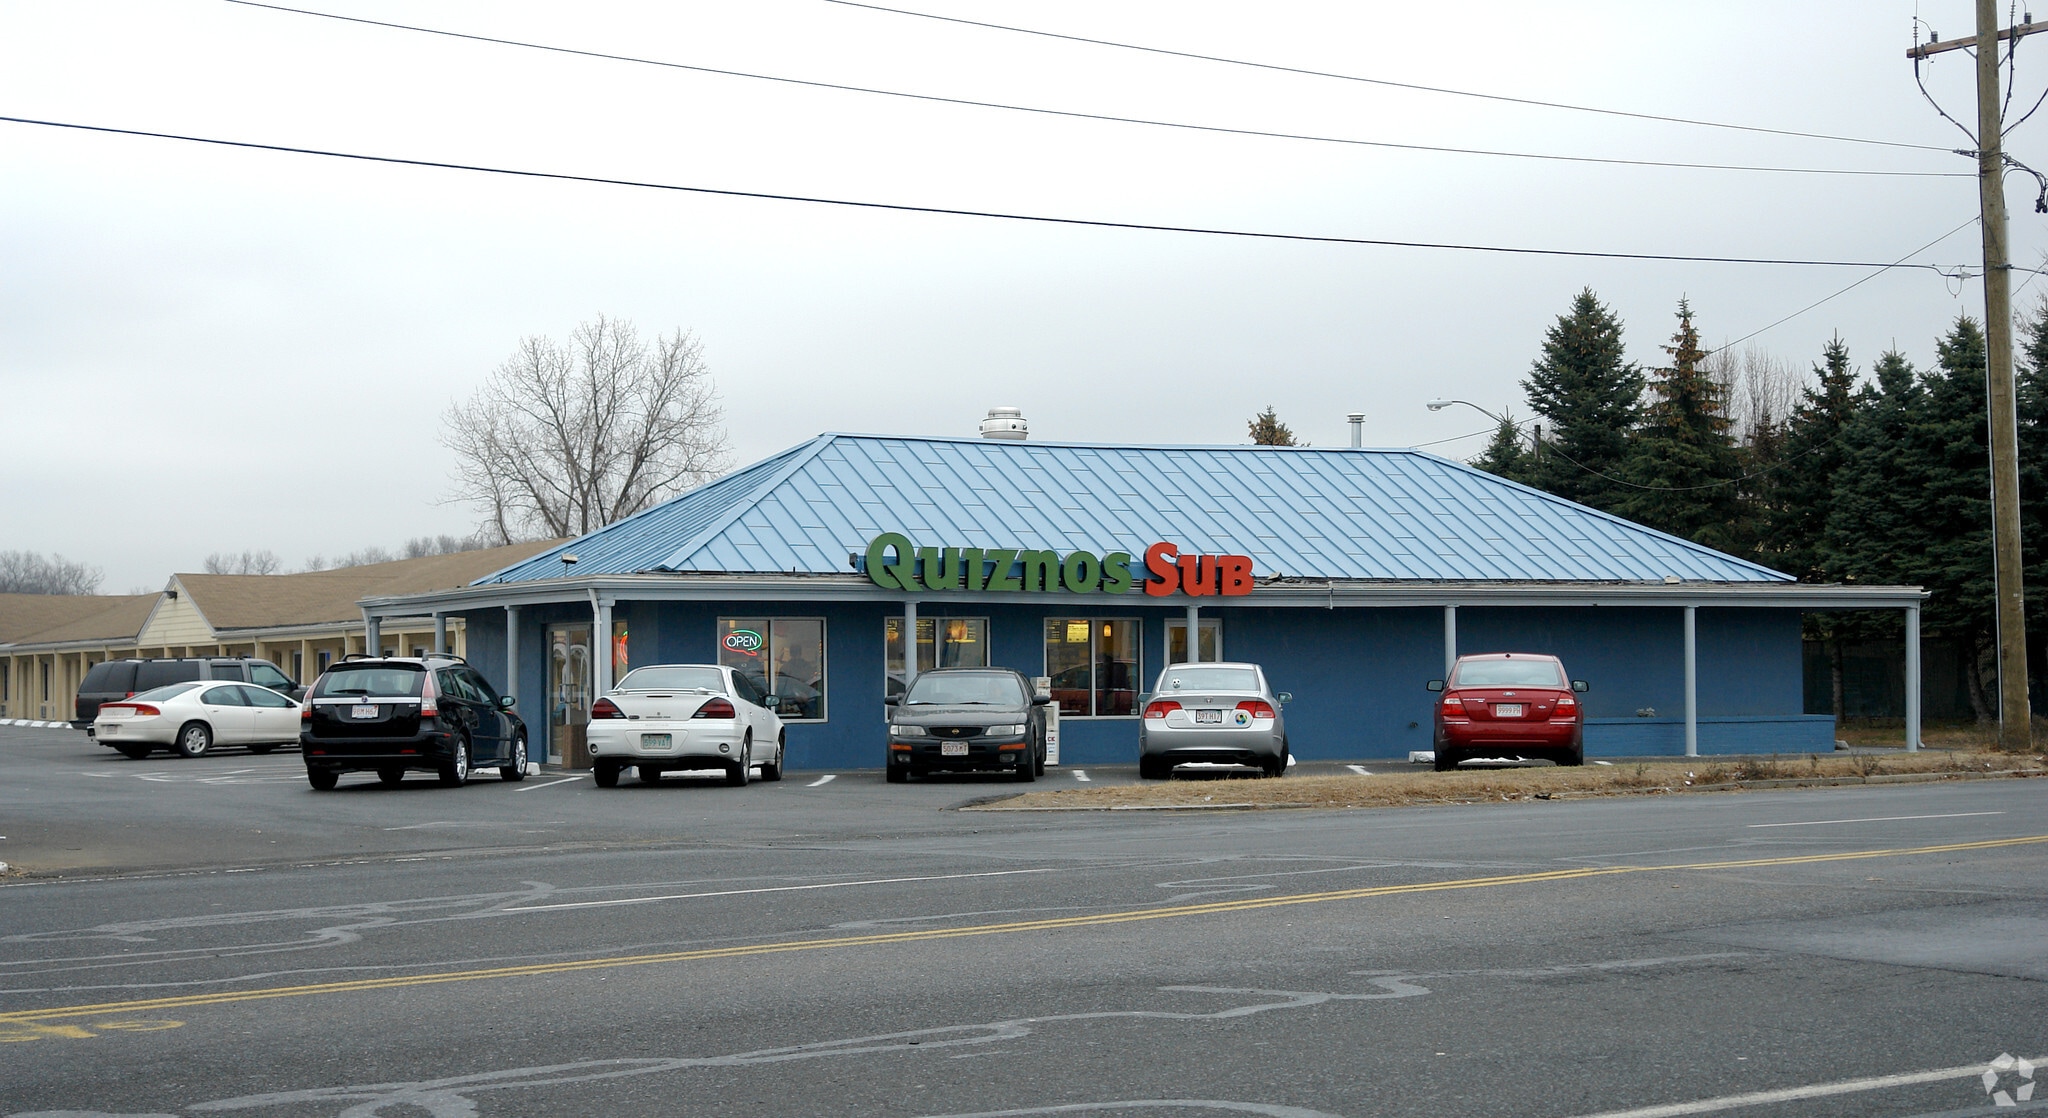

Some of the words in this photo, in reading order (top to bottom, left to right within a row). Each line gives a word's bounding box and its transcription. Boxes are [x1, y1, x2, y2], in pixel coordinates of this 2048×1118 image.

[865, 532, 1131, 594] Quiznos
[726, 635, 758, 648] OPEN
[1197, 712, 1209, 720] 39T
[942, 745, 958, 753] 5073
